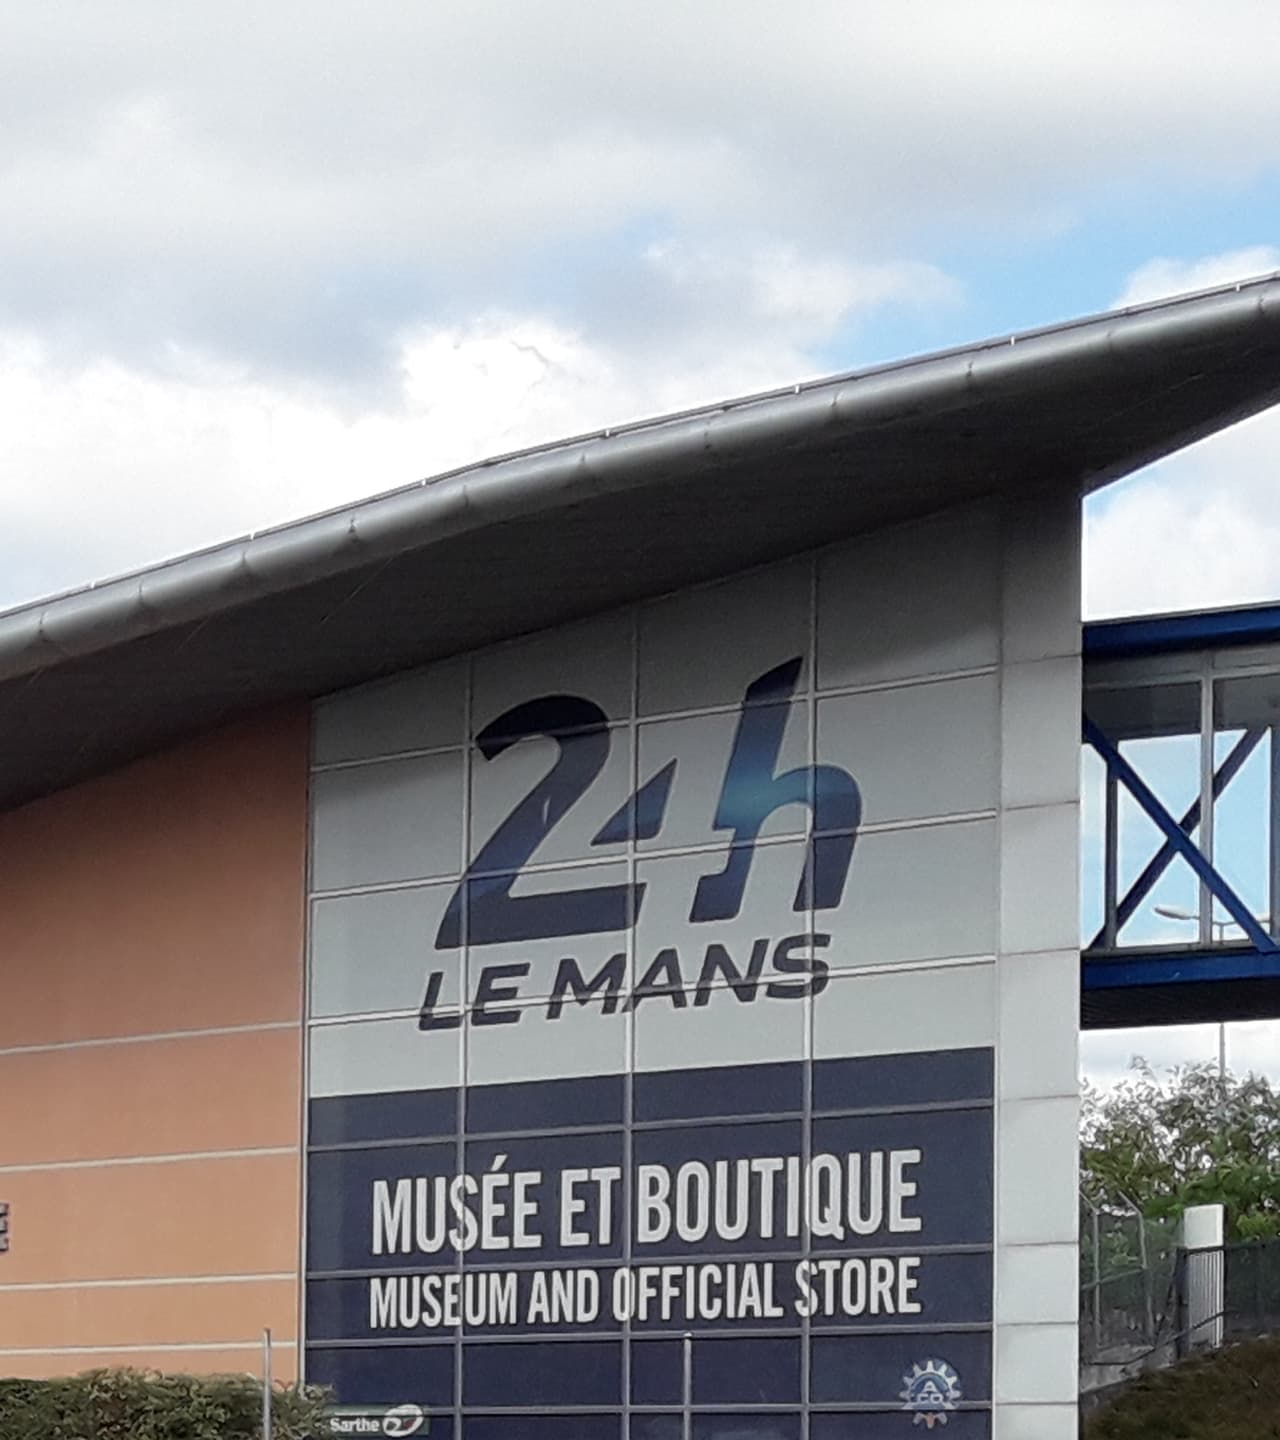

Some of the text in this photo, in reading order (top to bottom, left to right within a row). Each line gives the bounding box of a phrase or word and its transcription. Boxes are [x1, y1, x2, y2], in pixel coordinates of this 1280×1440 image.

[435, 656, 862, 951] 24h
[418, 934, 831, 1031] LE MANS
[372, 1149, 922, 1255] MUSÉE ET BOUTIQUE
[370, 1256, 921, 1329] MUSEUM AND OFFICIAL STORE
[329, 1417, 380, 1433] Sarthe
